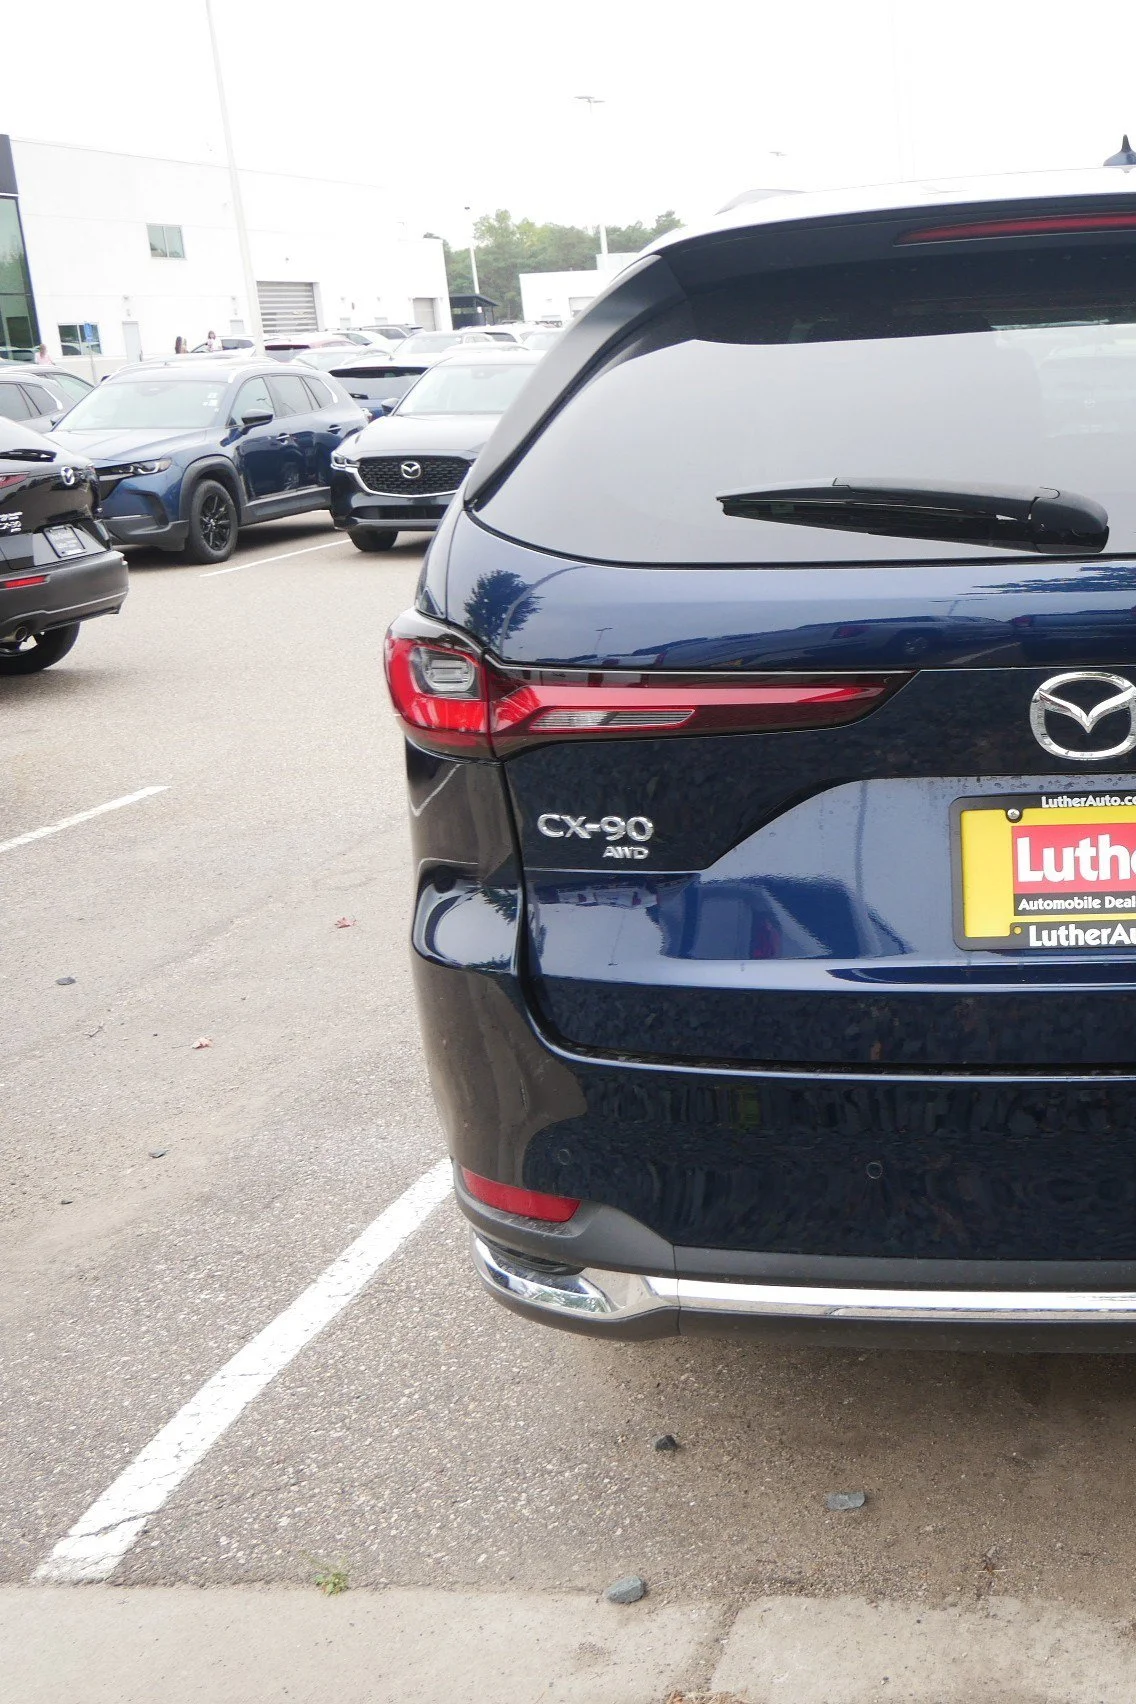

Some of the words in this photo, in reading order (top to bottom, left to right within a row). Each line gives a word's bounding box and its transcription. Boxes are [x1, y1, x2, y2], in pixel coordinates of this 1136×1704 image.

[536, 813, 655, 842] CX-90
[602, 846, 649, 860] AWD
[1018, 896, 1101, 911] Automobile
